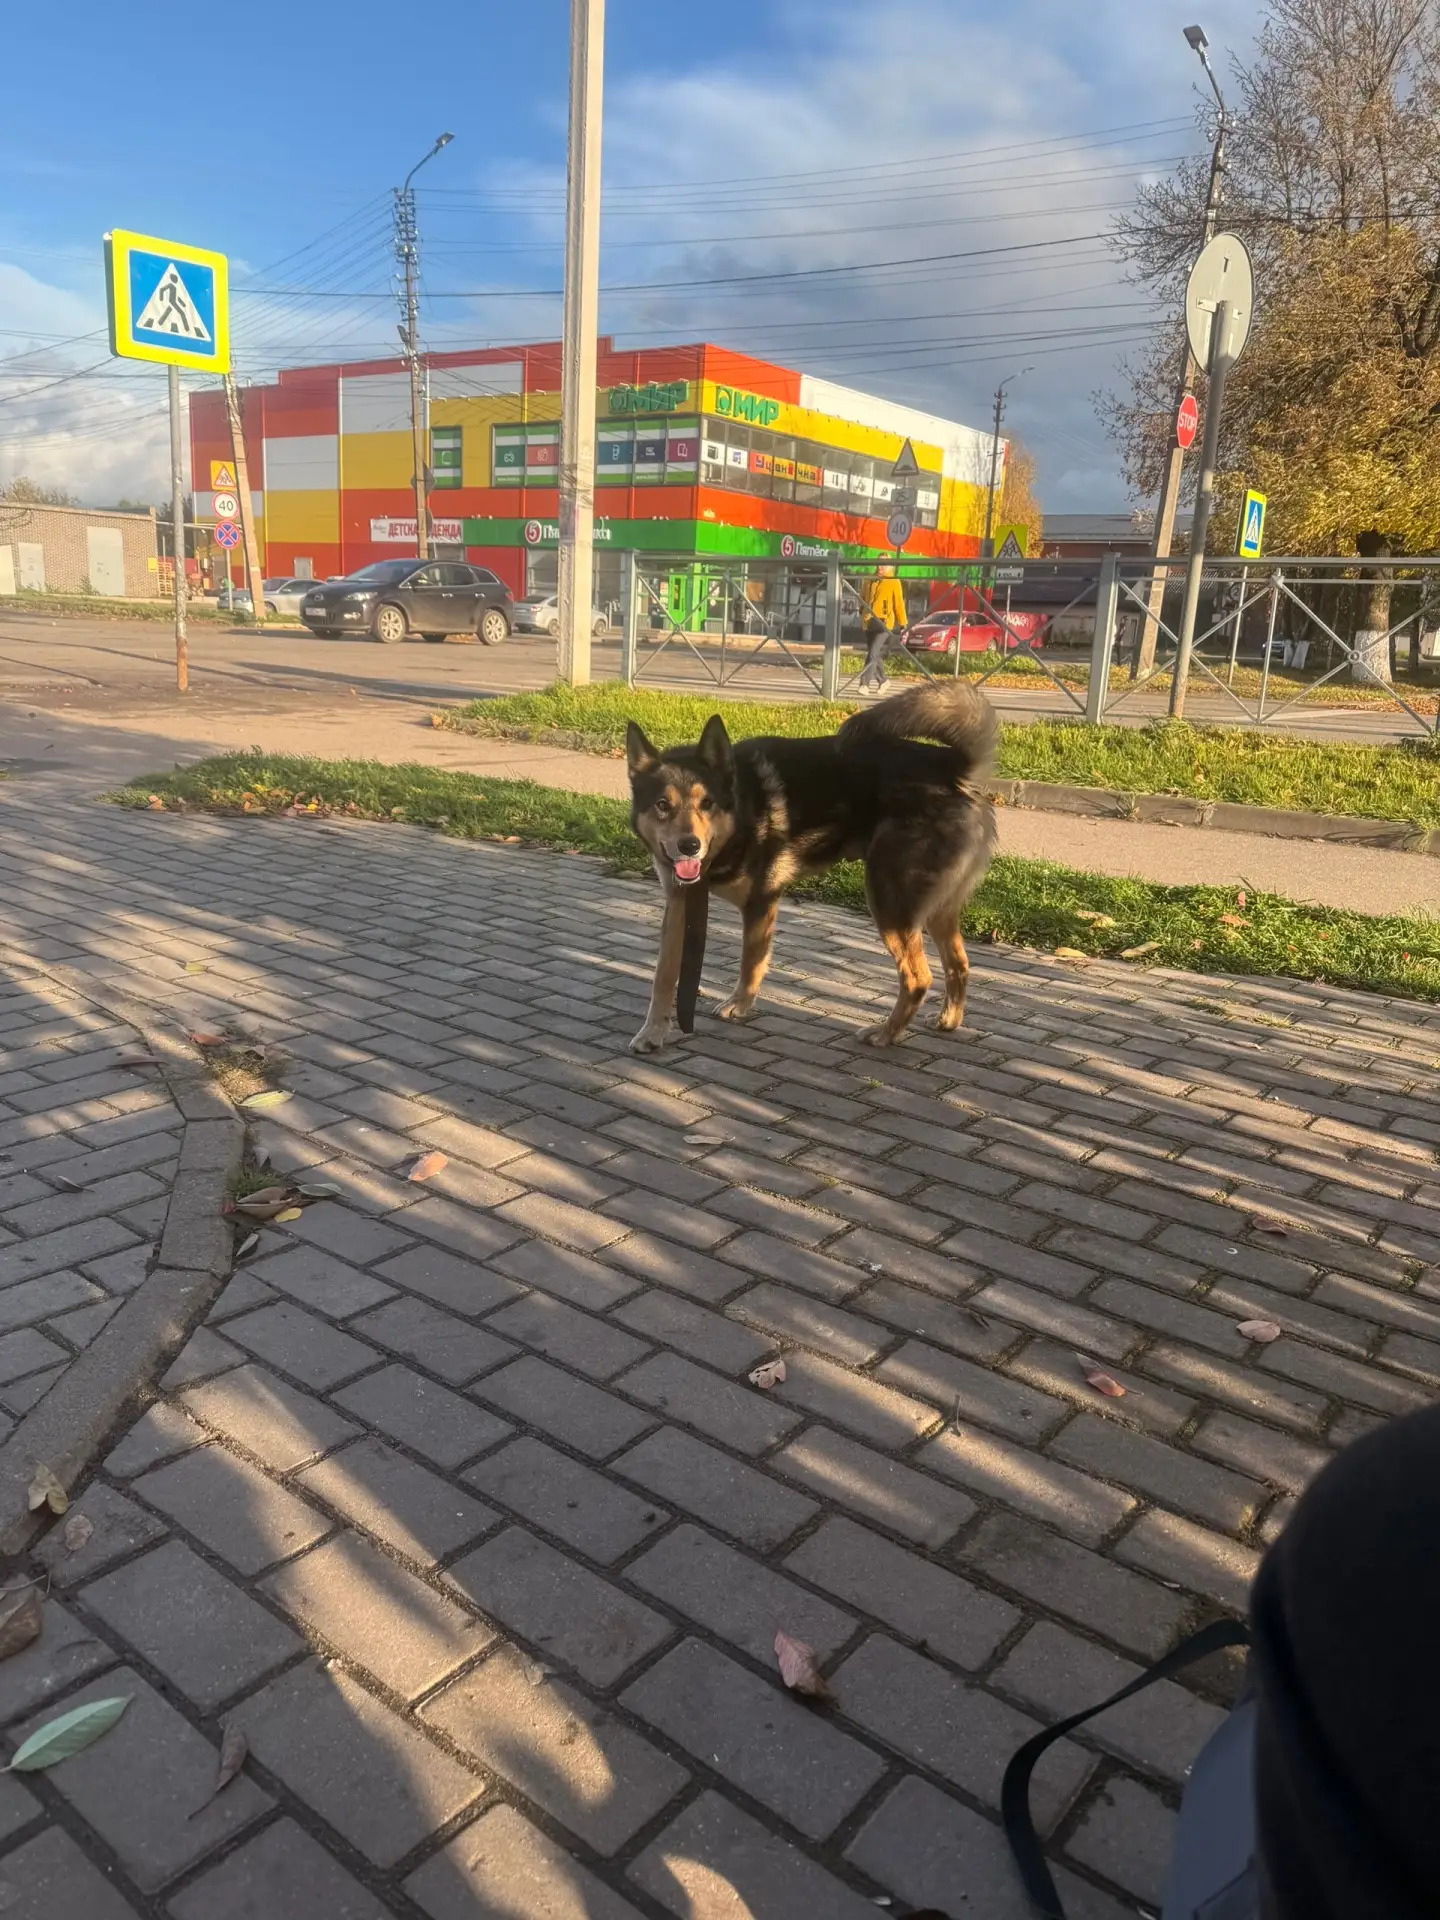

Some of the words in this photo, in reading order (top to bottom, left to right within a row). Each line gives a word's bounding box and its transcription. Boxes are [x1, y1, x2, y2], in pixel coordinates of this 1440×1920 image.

[627, 381, 689, 412] МИР
[733, 391, 779, 426] МИР
[1179, 411, 1196, 432] STOP
[218, 500, 234, 511] 40
[387, 522, 419, 538] ДЕТСКА
[430, 523, 462, 538] ДЕЖДА
[891, 521, 907, 535] 40
